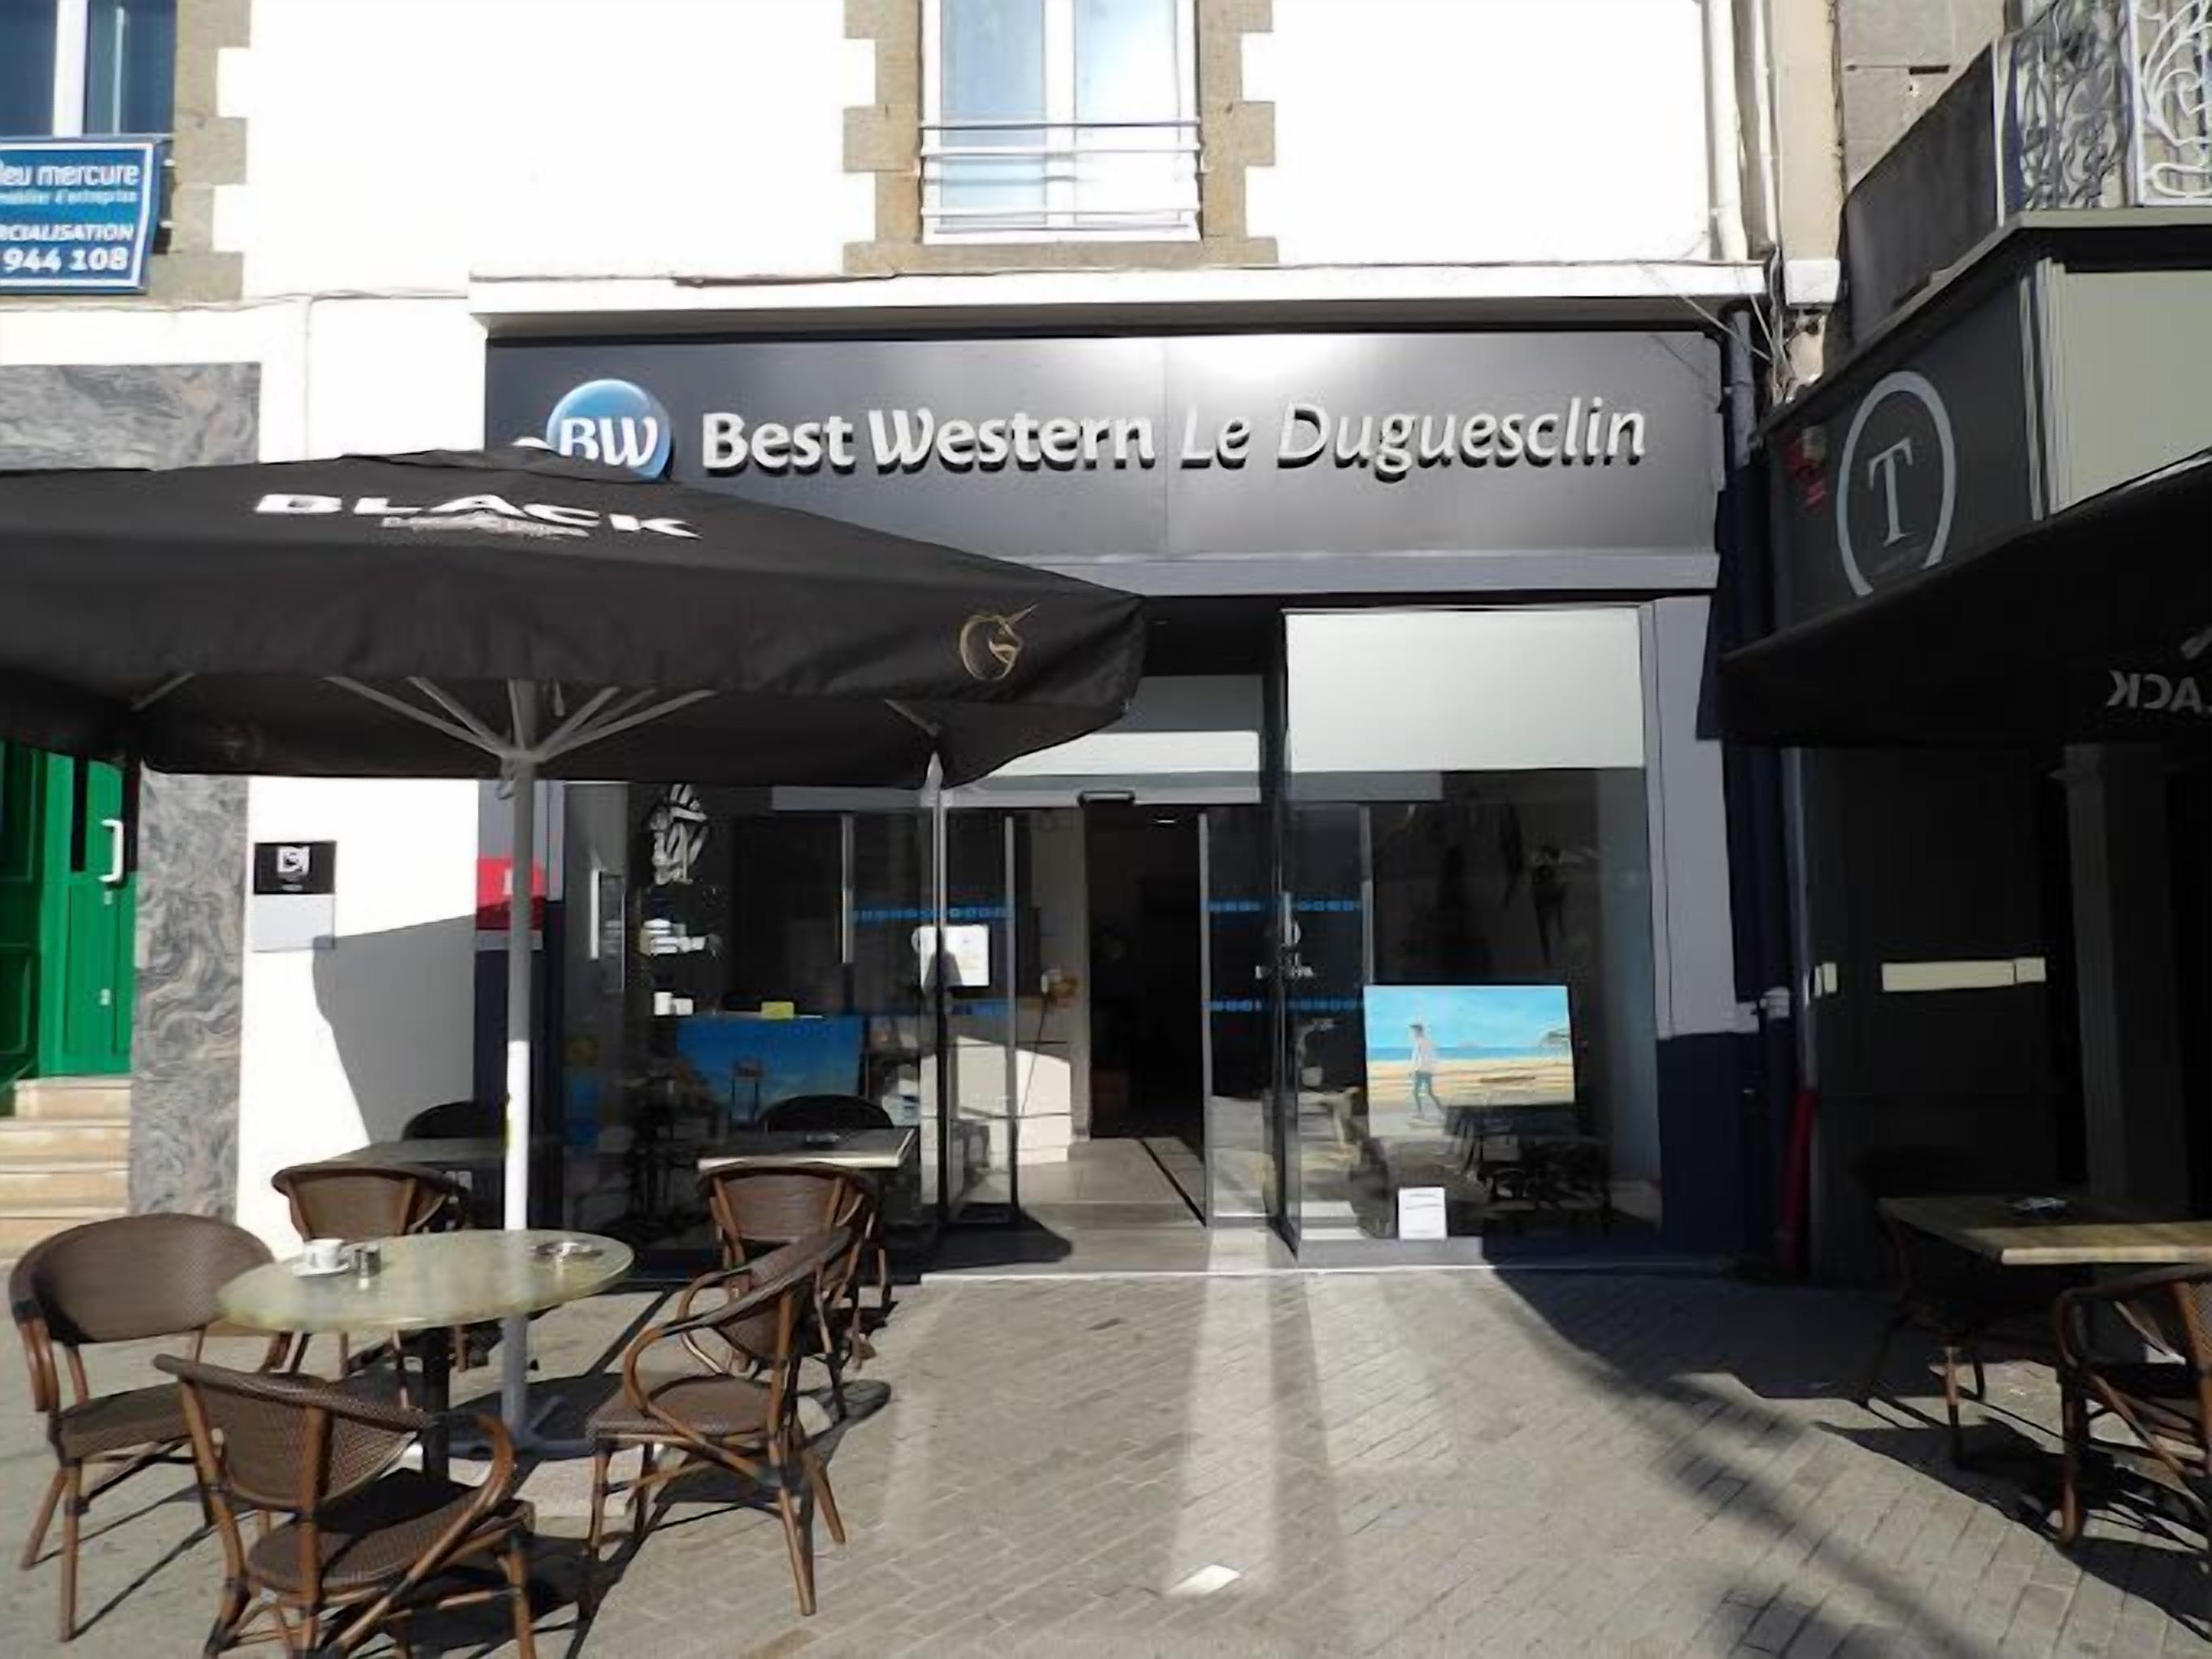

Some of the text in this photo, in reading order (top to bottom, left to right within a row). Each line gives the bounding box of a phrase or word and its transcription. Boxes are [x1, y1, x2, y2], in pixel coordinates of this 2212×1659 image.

[37, 164, 139, 185] mercure
[3, 246, 128, 273] 944 108
[702, 396, 1646, 484] Best Western Le Duguesclin
